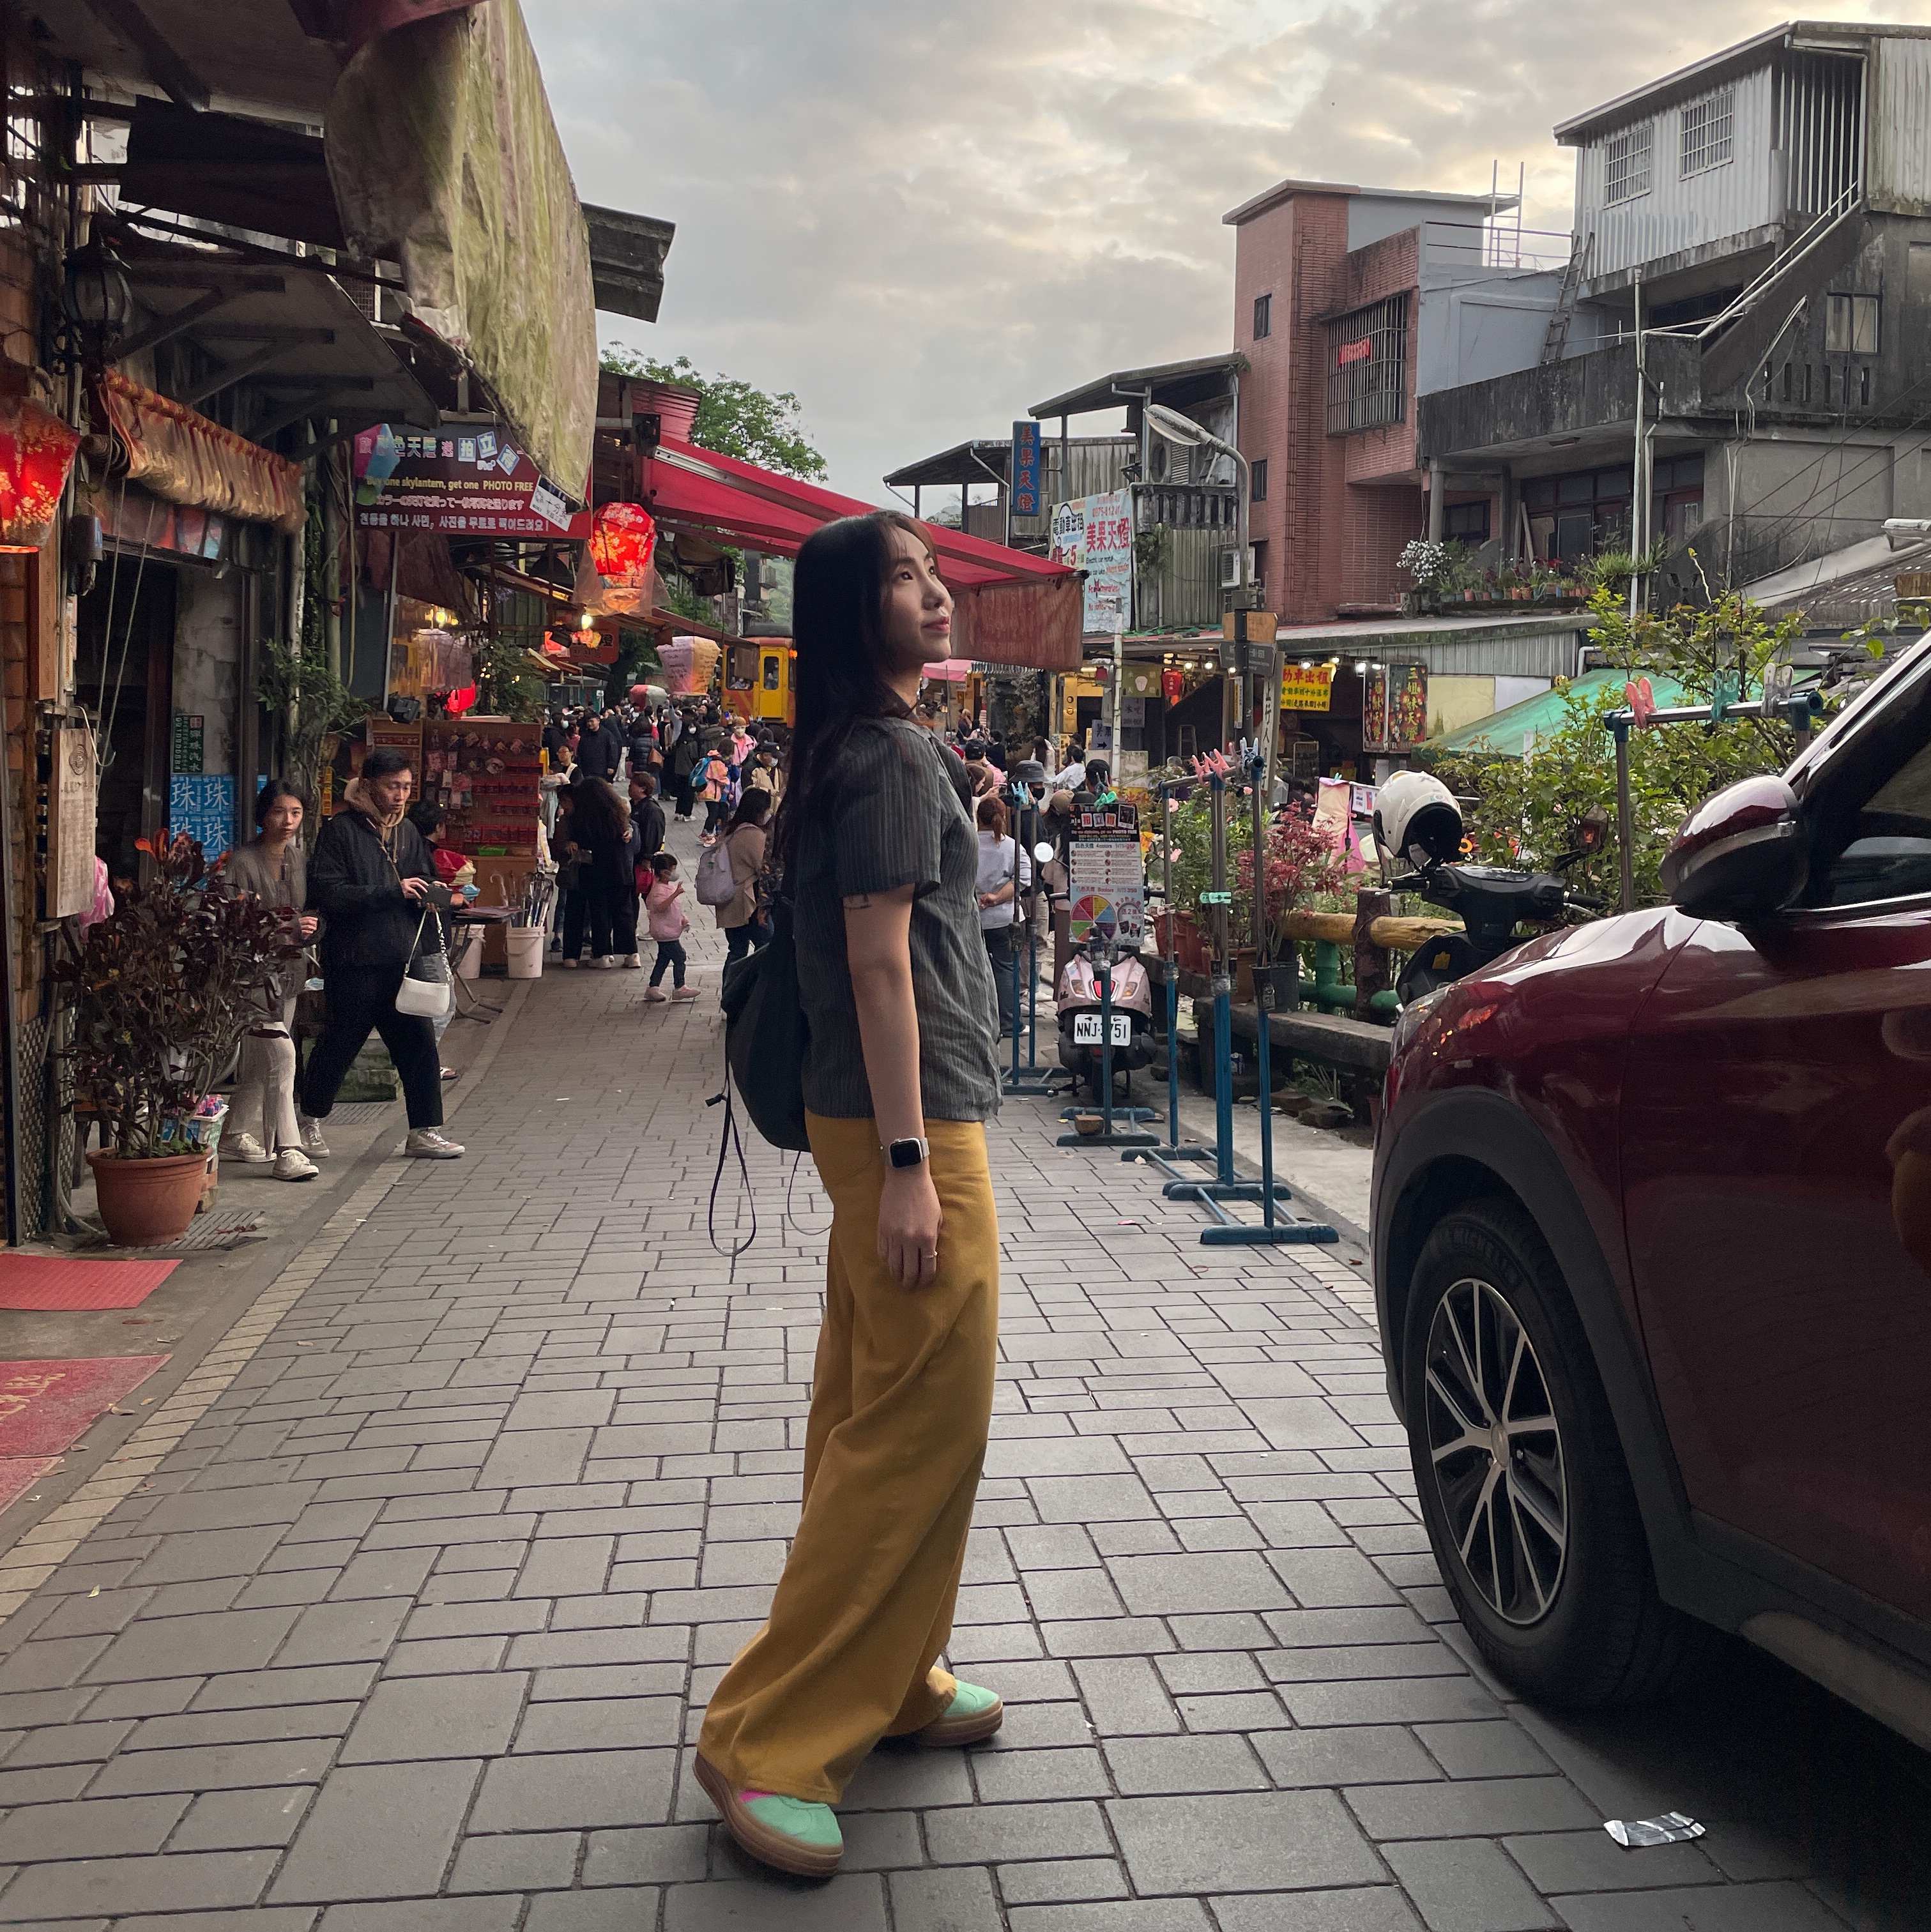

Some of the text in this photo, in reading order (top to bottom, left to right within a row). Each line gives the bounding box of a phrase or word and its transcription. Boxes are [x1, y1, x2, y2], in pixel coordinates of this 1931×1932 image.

[448, 480, 462, 491] get
[464, 481, 479, 489] one
[483, 480, 513, 491] PHOTO
[514, 481, 534, 492] FREE
[1018, 425, 1035, 512] 美果天燈
[1053, 513, 1083, 535] 電動車出租
[1087, 517, 1131, 554] 美果天燈
[1406, 667, 1419, 742] 三姐妹天燈
[171, 777, 197, 812] 珠
[204, 777, 230, 812] 珠
[203, 817, 230, 851] 珠
